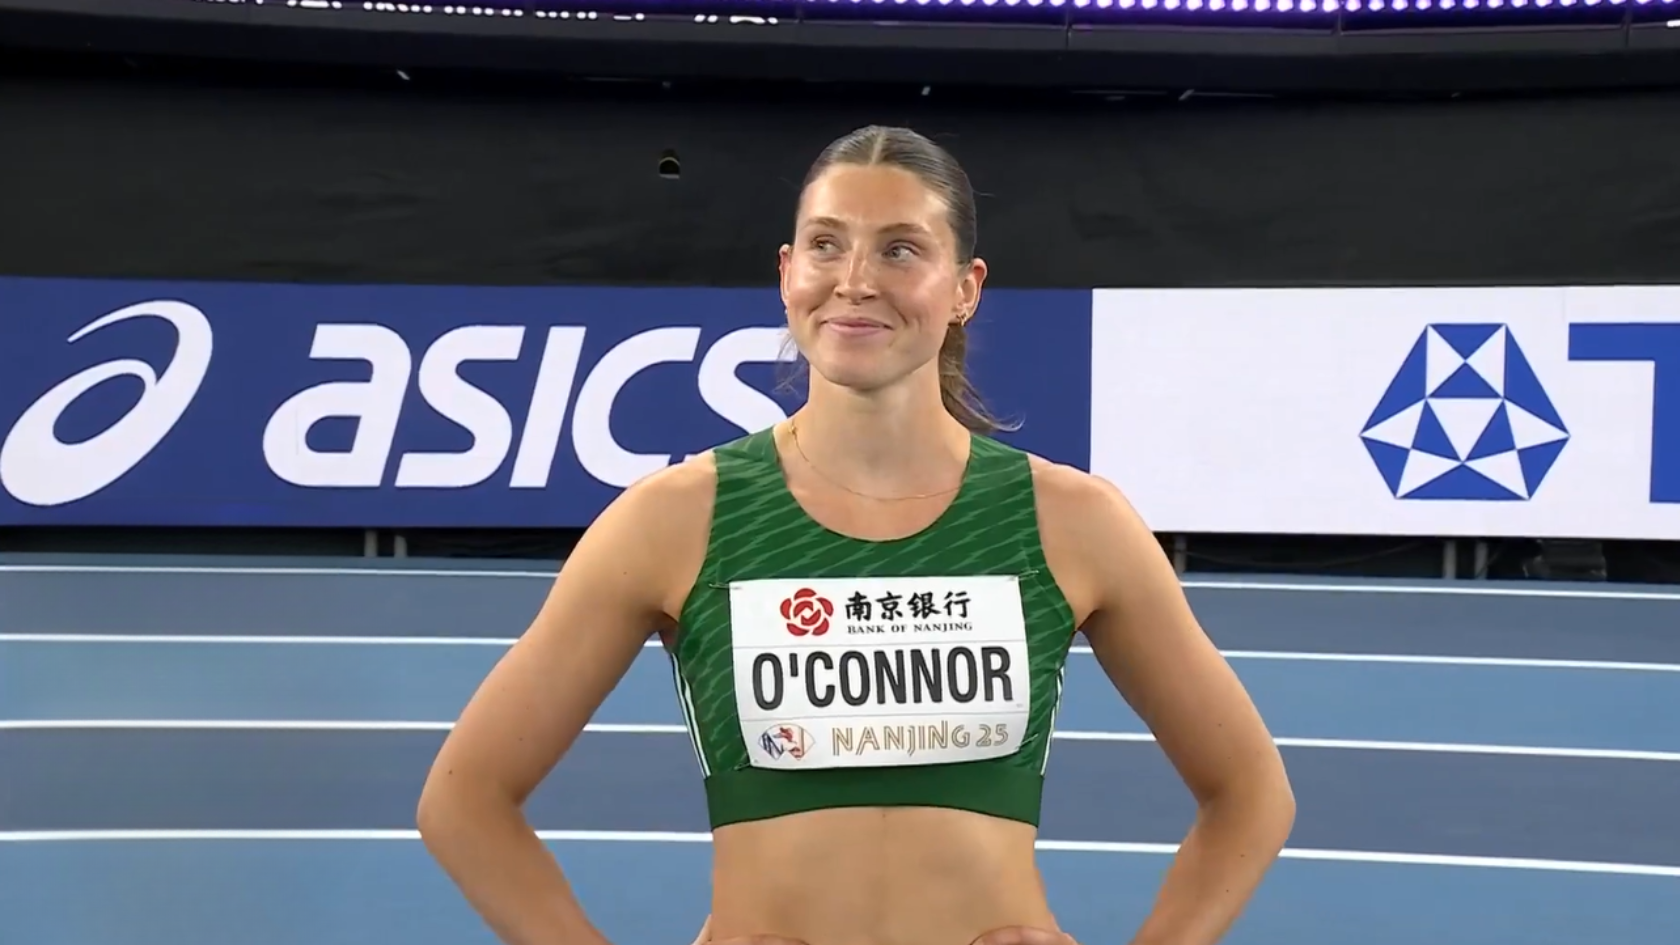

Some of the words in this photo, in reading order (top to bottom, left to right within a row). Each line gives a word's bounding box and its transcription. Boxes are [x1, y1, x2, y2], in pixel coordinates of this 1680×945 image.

[845, 590, 971, 622] 南京银行
[847, 624, 885, 634] BANK
[891, 624, 908, 633] OF
[914, 621, 973, 633] NANJING
[752, 646, 1013, 711] O'CONNOR
[976, 723, 1009, 747] 25
